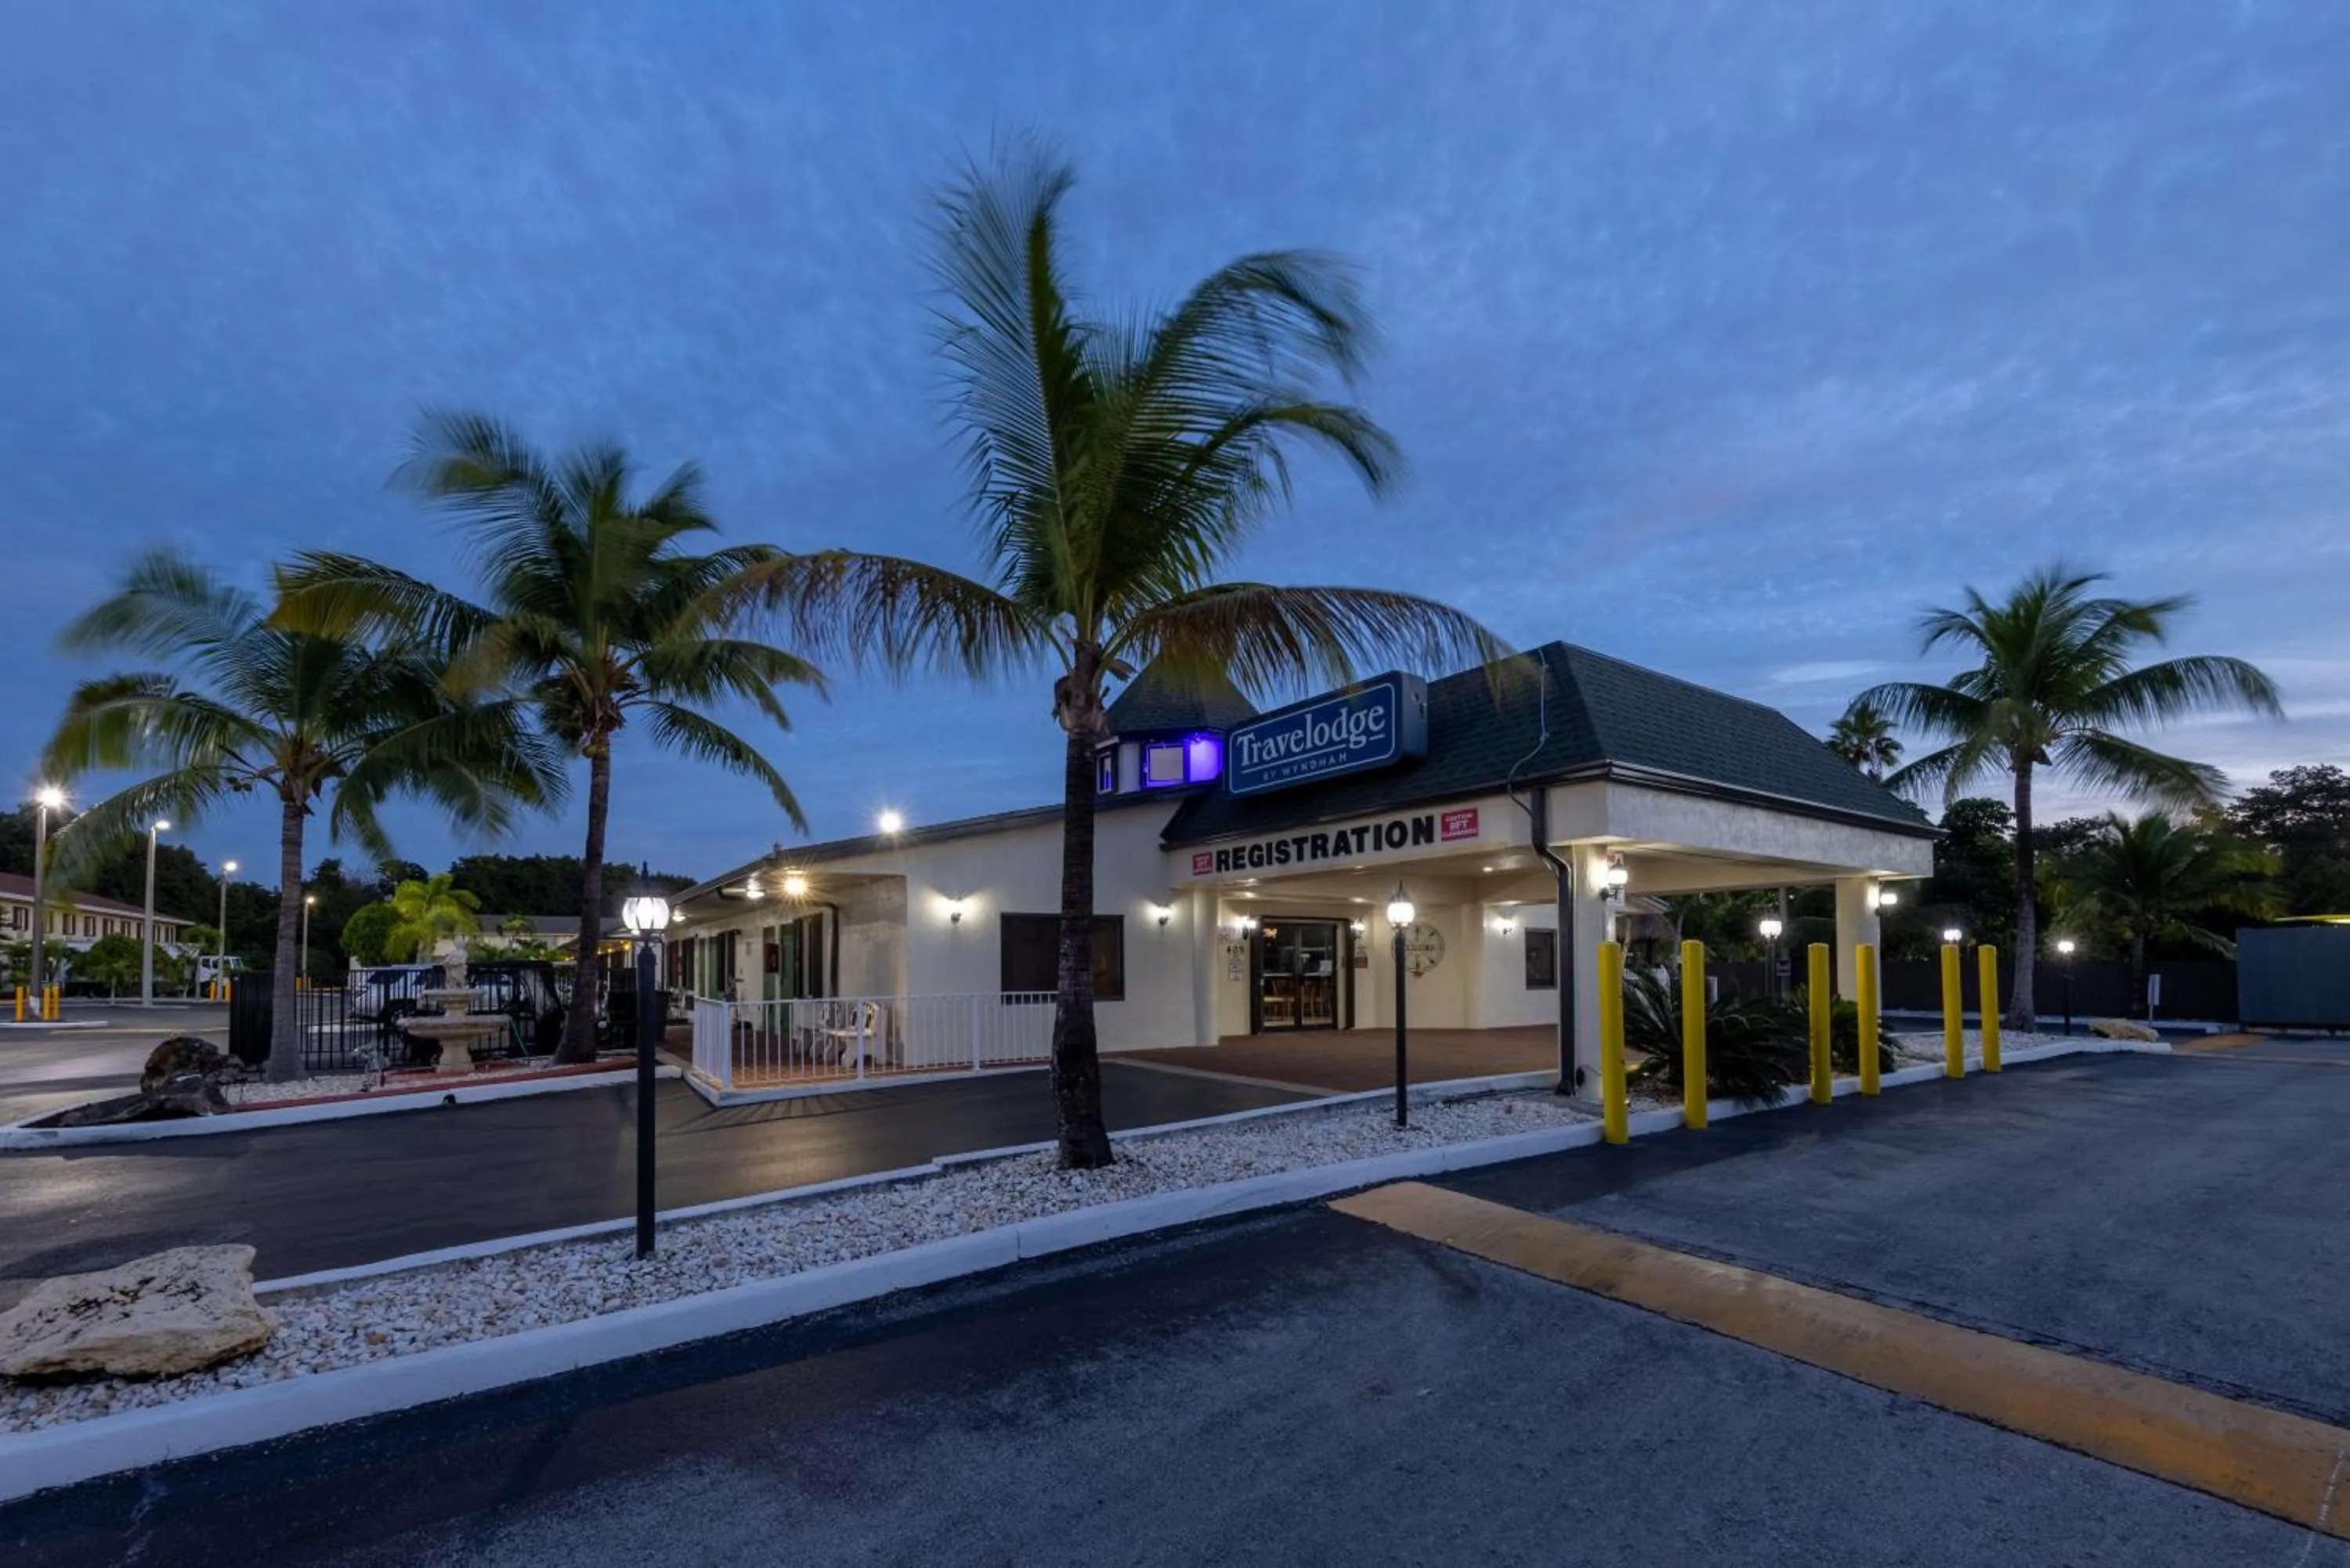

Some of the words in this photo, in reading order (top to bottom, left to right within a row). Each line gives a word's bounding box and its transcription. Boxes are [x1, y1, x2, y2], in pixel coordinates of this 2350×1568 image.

[1236, 705, 1386, 767] Travelodge
[1263, 769, 1276, 781] BY
[1282, 751, 1348, 777] WYNDHAM
[1216, 815, 1435, 873] REGISTRATION
